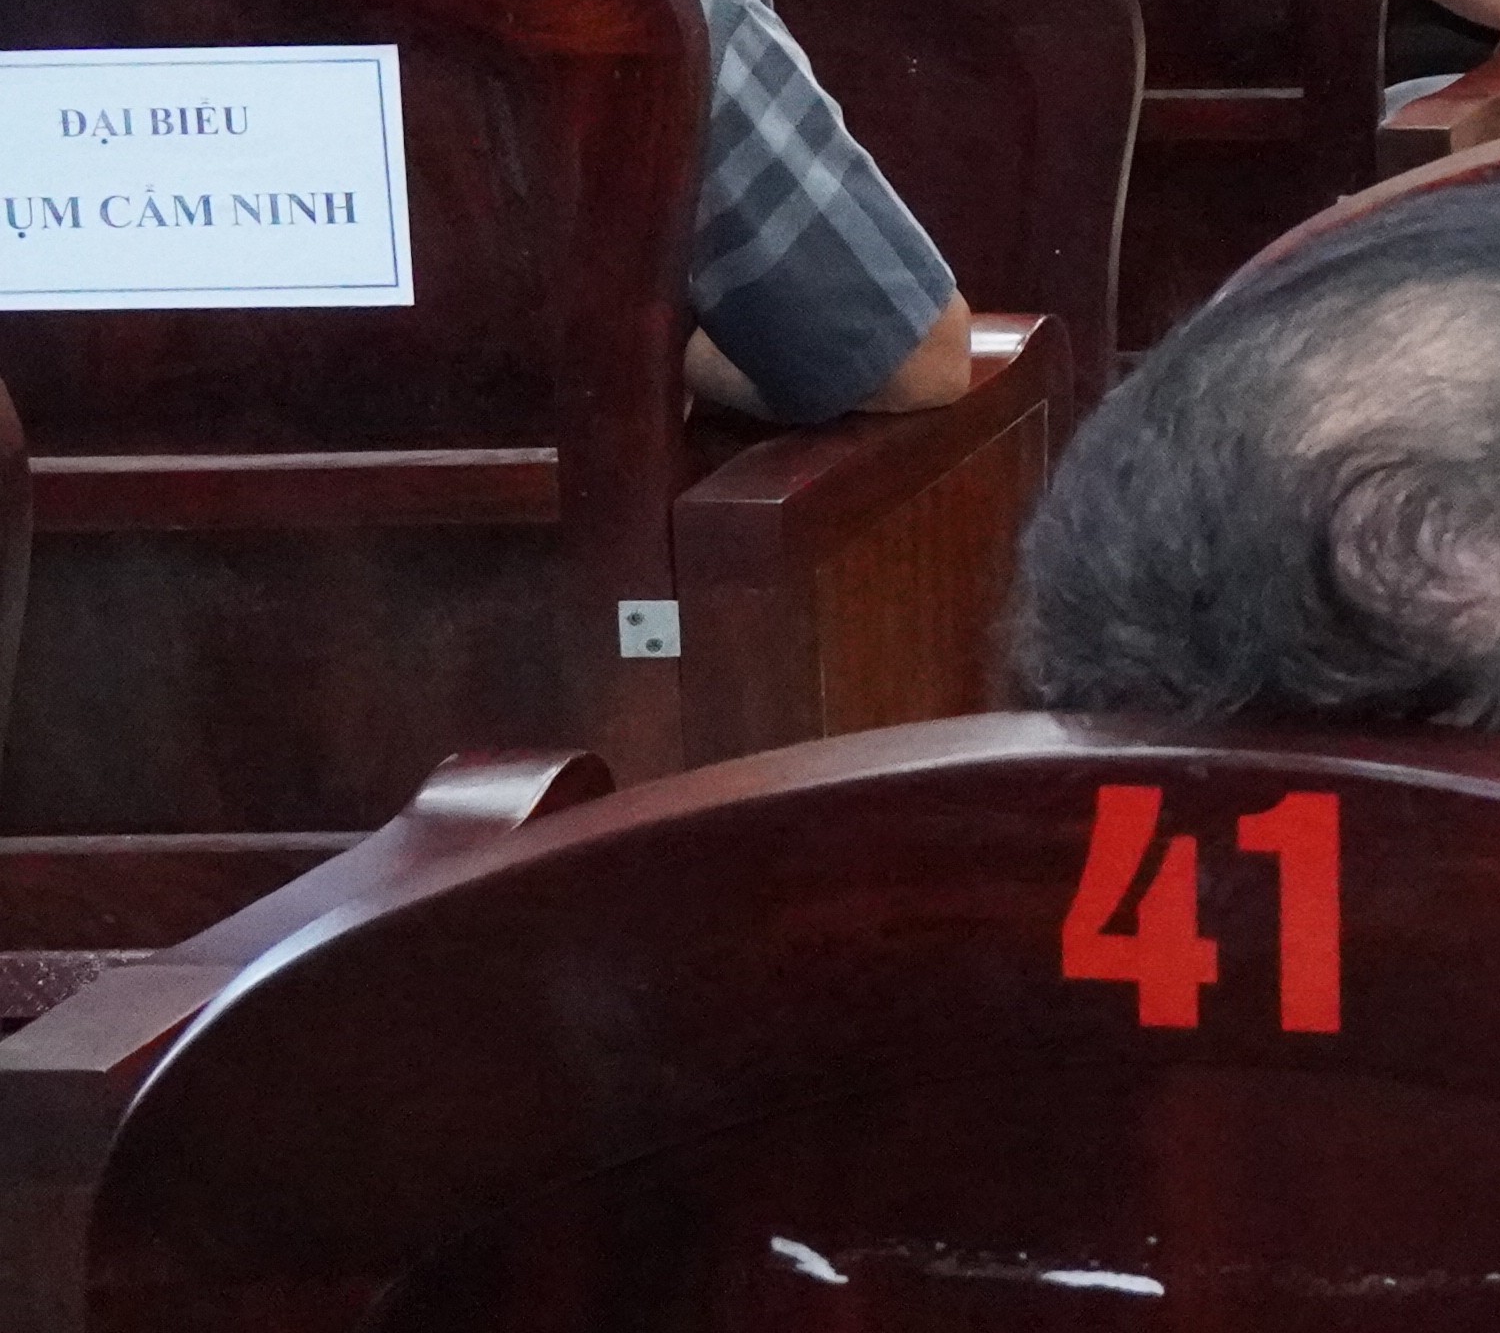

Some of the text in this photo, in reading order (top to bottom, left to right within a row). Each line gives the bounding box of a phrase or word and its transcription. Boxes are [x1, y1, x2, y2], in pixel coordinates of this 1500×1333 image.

[58, 98, 248, 144] ĐẠI BIỂU
[231, 192, 358, 225] NINH
[1062, 784, 1341, 1032] 41
